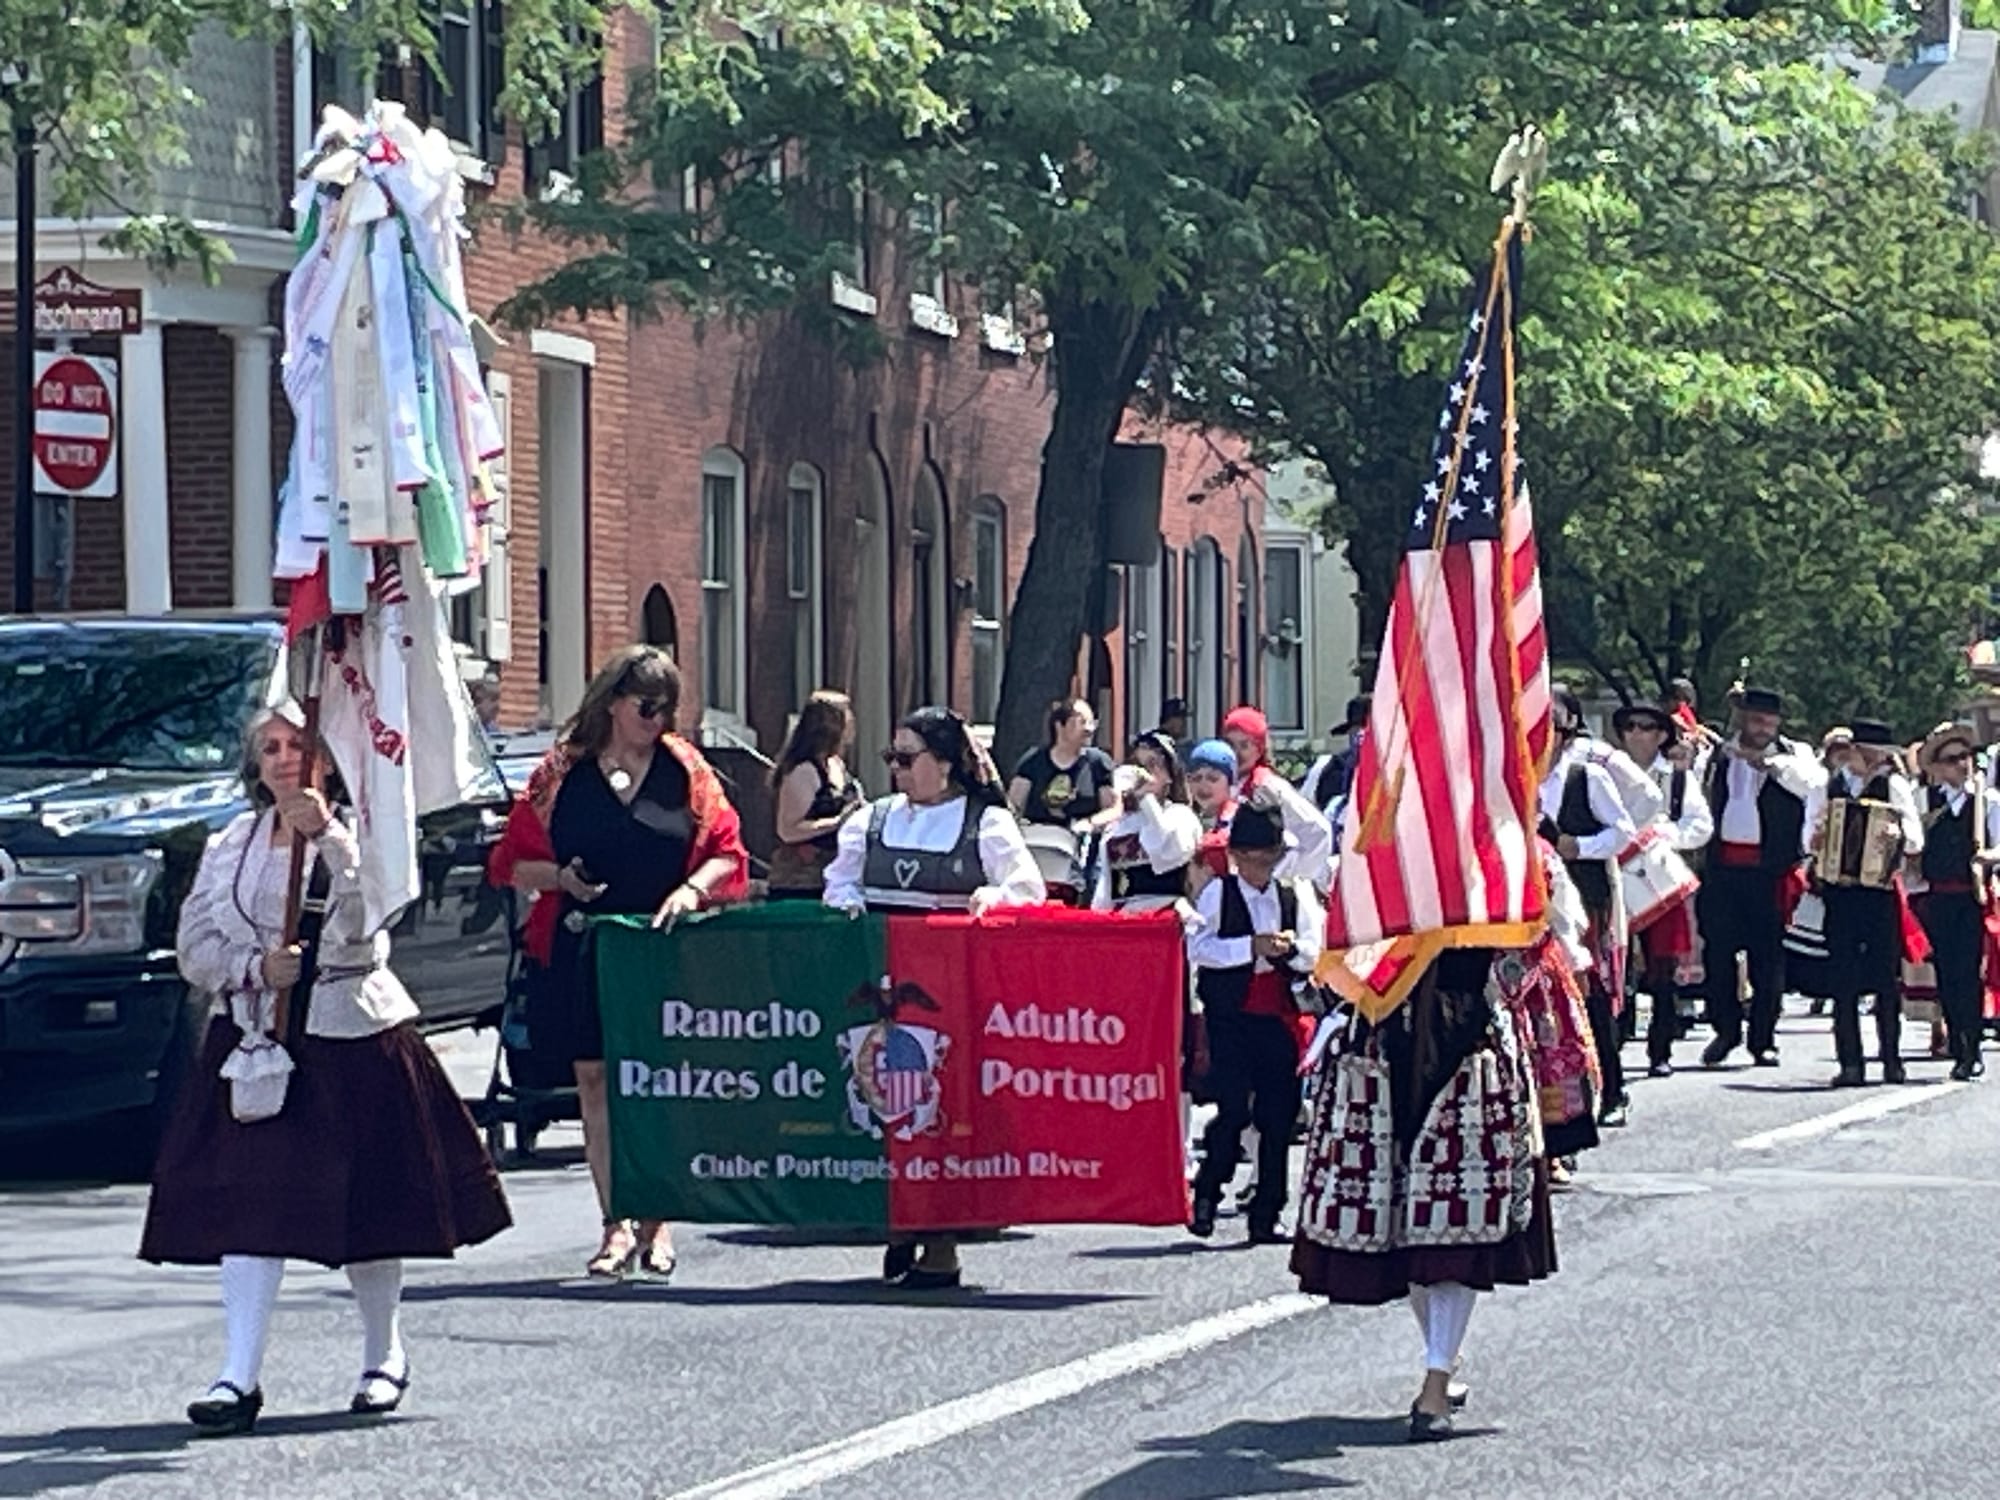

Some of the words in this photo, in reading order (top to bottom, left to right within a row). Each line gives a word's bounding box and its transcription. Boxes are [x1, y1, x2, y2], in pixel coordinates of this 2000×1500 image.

[42, 381, 65, 405] DO
[71, 385, 104, 407] NOT
[47, 442, 97, 467] ENTER
[662, 1000, 821, 1038] Rancho
[984, 1002, 1126, 1045] Adulto
[772, 1060, 826, 1098] de
[981, 1058, 1166, 1111] Portugal
[905, 1155, 940, 1181] de
[943, 1152, 1021, 1180] South
[1028, 1151, 1103, 1179] River
